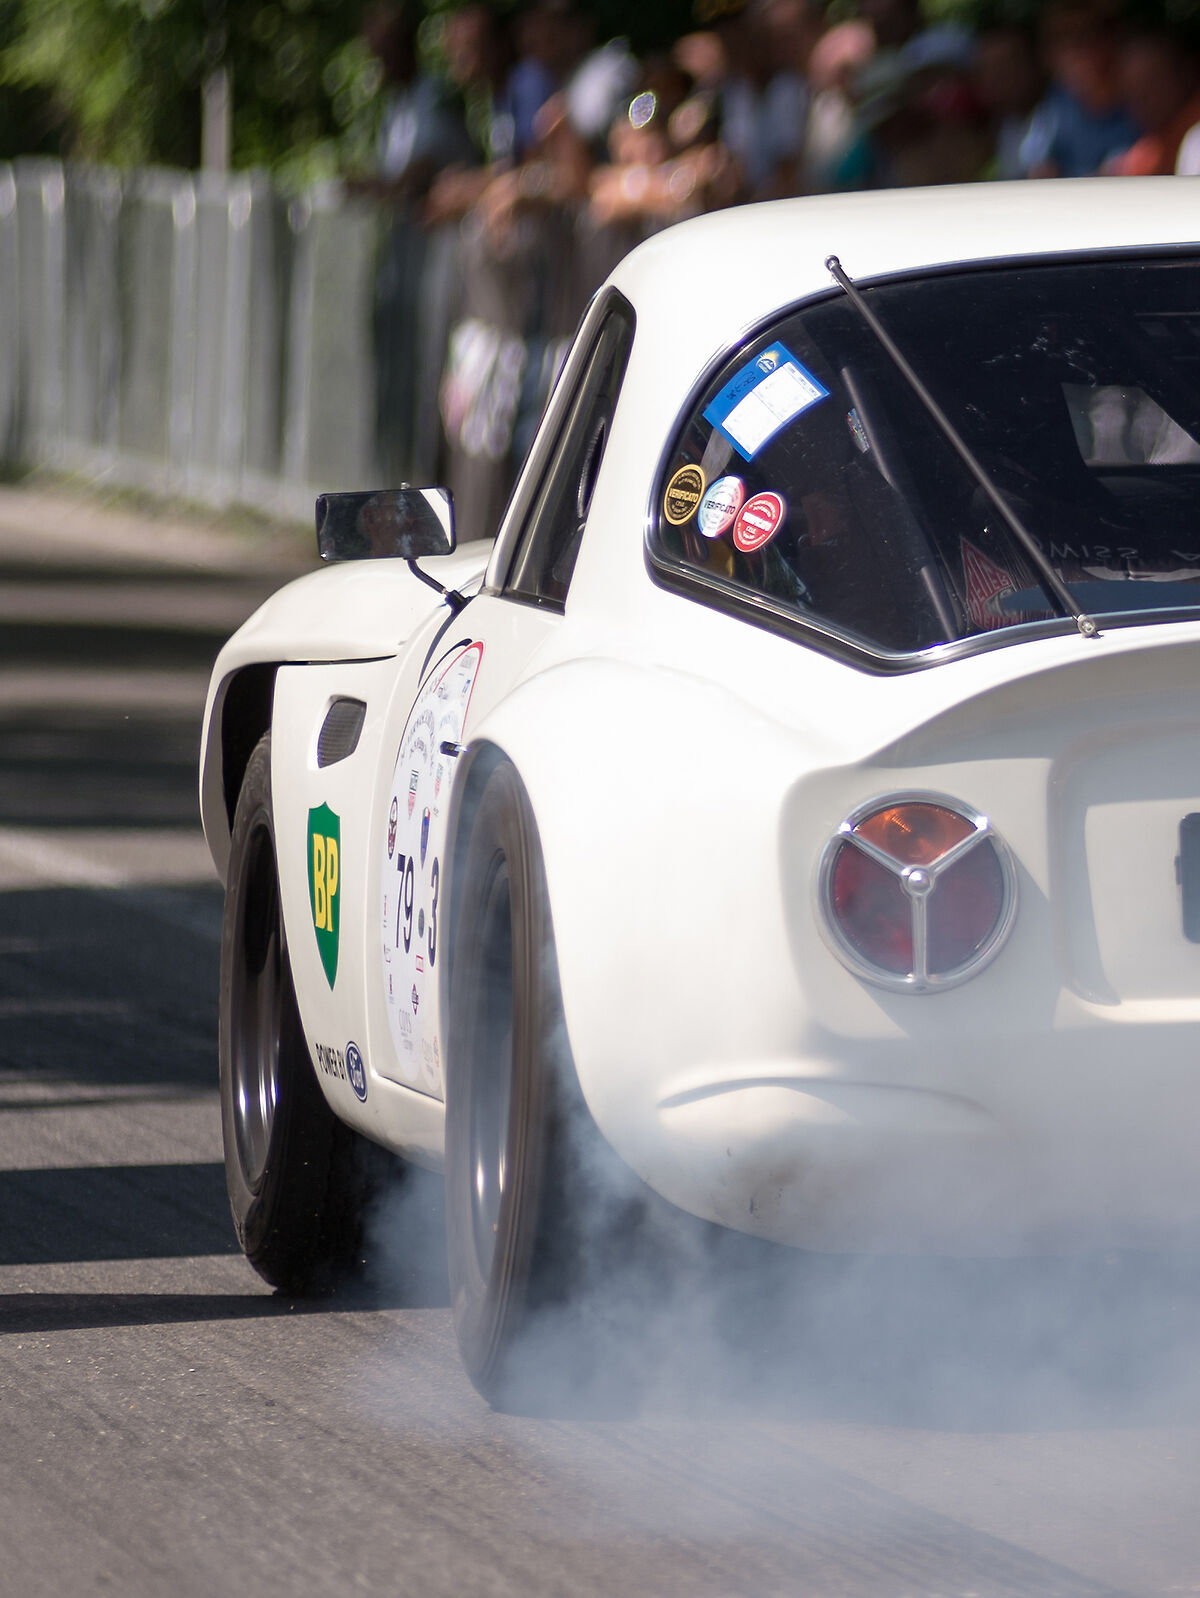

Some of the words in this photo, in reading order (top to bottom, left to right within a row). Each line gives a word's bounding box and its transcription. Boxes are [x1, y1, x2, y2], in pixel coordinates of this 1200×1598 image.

[668, 487, 700, 504] VERIFICATO
[703, 499, 737, 516] VERIFICATO
[312, 832, 339, 933] BP
[395, 852, 414, 954] 79
[348, 1048, 365, 1091] Ford
